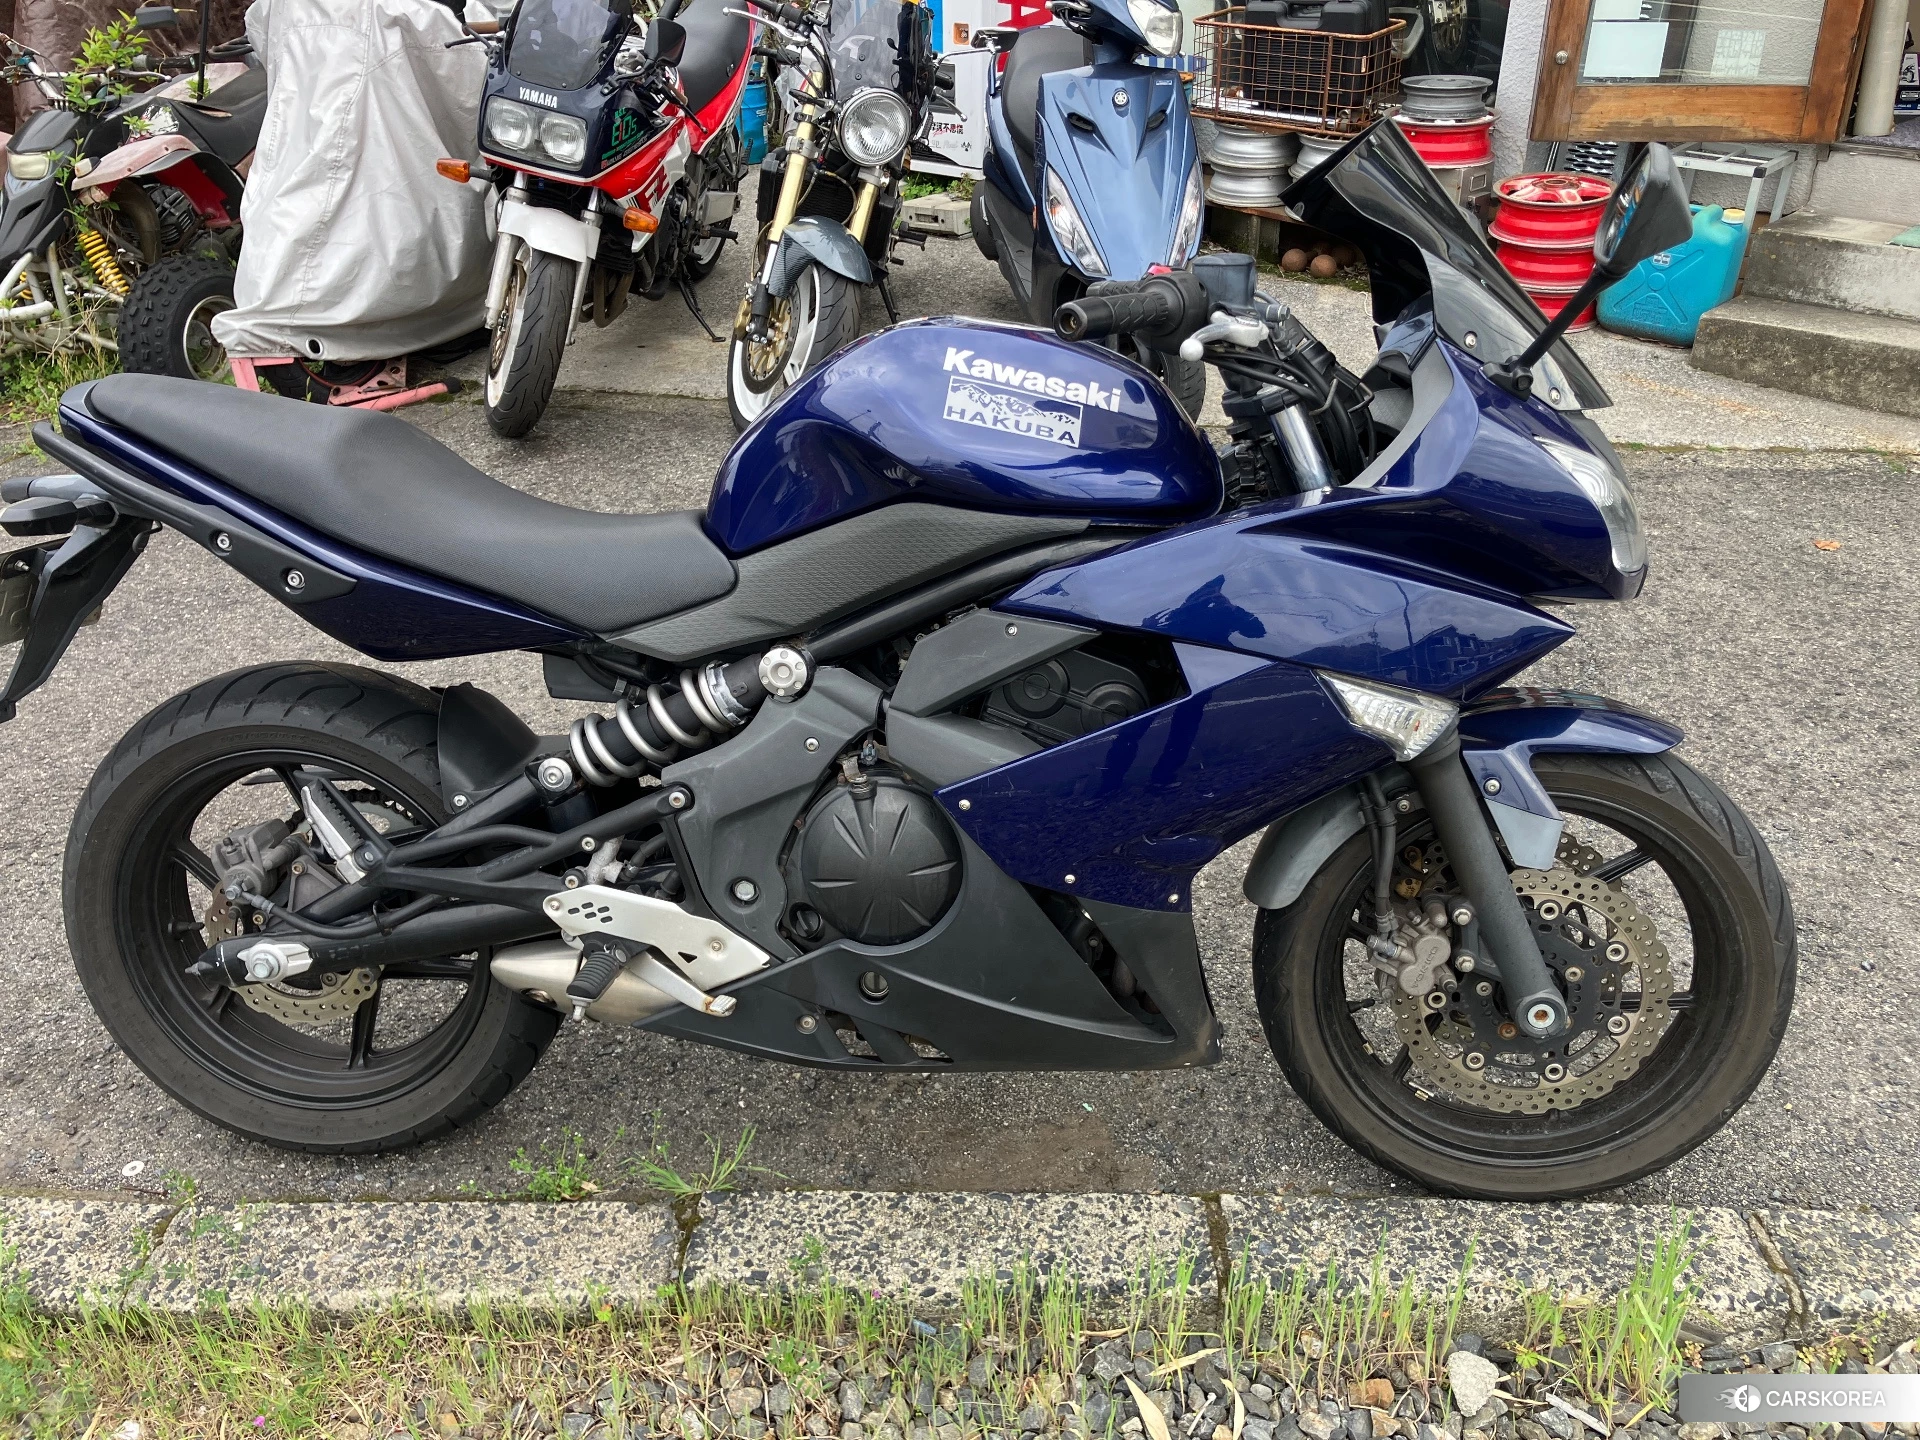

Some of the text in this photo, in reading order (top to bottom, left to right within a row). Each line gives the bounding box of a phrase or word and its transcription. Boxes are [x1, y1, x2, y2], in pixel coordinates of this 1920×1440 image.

[519, 86, 558, 109] YAMAHA
[942, 346, 1121, 413] Kawasaki
[946, 405, 1076, 445] HAKUBA
